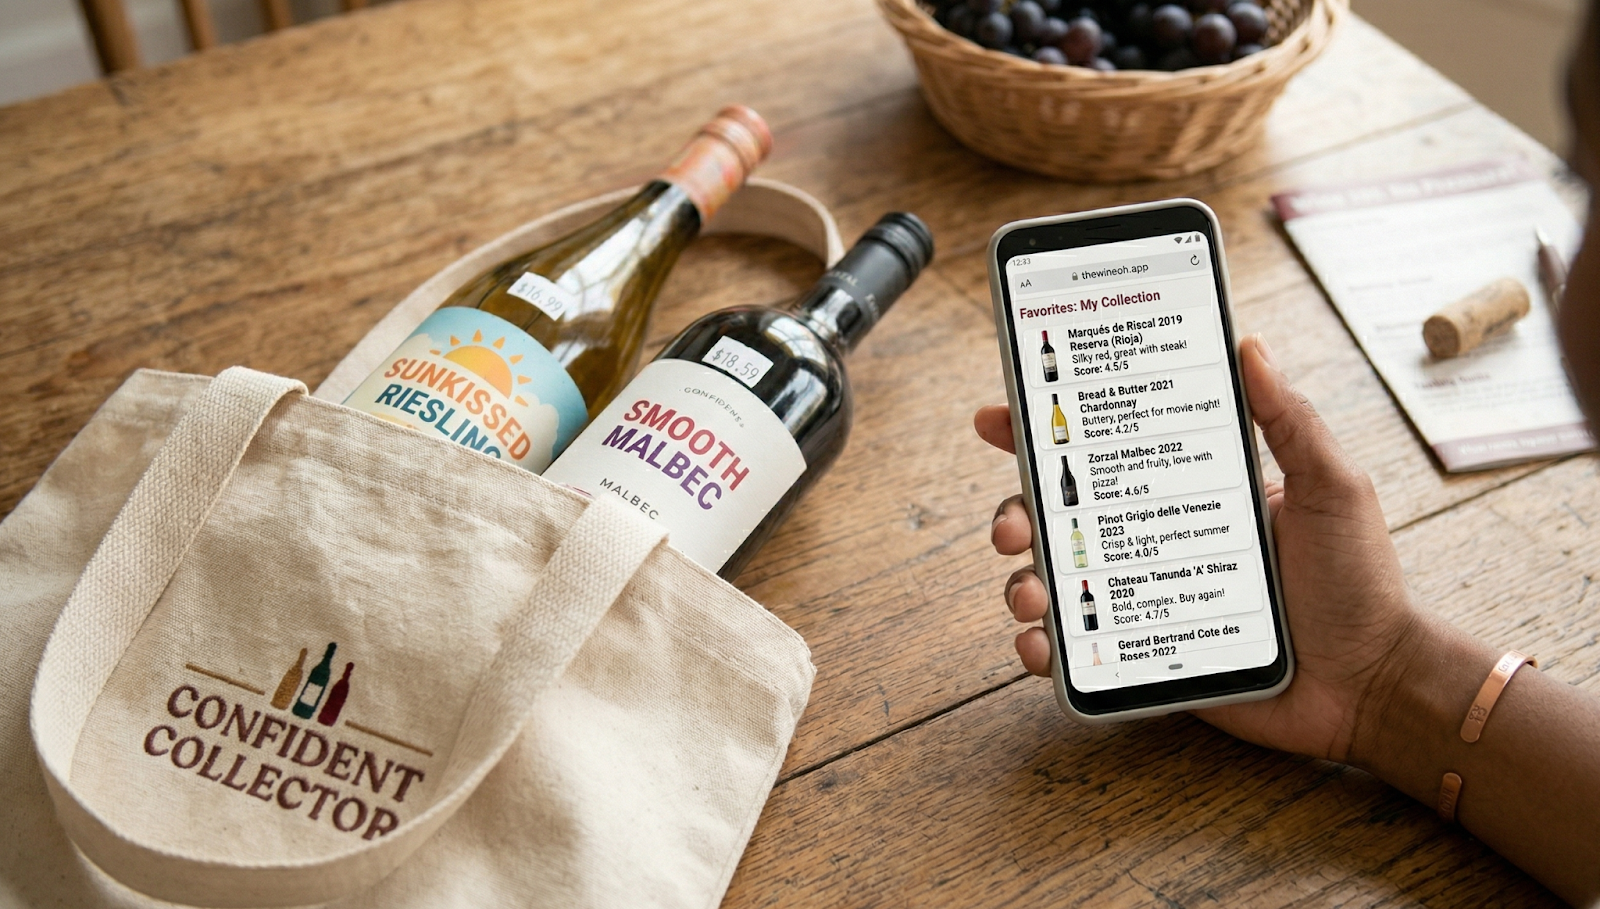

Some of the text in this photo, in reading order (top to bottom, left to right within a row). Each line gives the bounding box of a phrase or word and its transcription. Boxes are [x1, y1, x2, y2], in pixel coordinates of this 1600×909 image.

[1081, 263, 1149, 280] thewineoh.app
[517, 282, 563, 312] $16.99
[1020, 290, 1161, 319] Favorites: My Collection
[1068, 315, 1183, 341] Marqués de Riscal 2019
[1070, 333, 1143, 352] Reserva (Rioja)
[1072, 340, 1188, 366] Silky red, great with steak!
[712, 348, 760, 380] $18.59
[1074, 361, 1129, 376] Score: 4.5/5
[1078, 380, 1174, 402] Bread & Butter 2021
[384, 358, 531, 461] SUNKISSED
[1080, 398, 1137, 414] Chardonnay
[1082, 399, 1220, 427] Buttery, perfect for movie night!
[1084, 423, 1139, 439] Score: 4.2/5
[624, 400, 750, 491] SMOOTH
[1088, 442, 1183, 464] Zorzal Malbec 2022
[601, 425, 722, 510] MALBEC
[1090, 451, 1213, 476] Smooth and fruity, love with
[1092, 477, 1119, 490] pizza!
[1093, 484, 1150, 501] Score: 4.6/5
[600, 478, 659, 520] MALBEC
[1097, 500, 1221, 526] Pinot Grigio delle Venezie
[1100, 525, 1125, 538] 2023
[1101, 524, 1230, 551] Crisp & light, perfect summer
[1103, 546, 1159, 563] Score: 4.0/5
[1108, 560, 1238, 588] Chateau Tanunda 'A' Shiraz
[1109, 587, 1135, 600] 2020
[1112, 588, 1225, 614] Bold, complex. Buy again!
[1113, 609, 1170, 625] Score: 4.7/5
[1118, 625, 1240, 650] Gerard Bertrand Cote des
[1120, 645, 1177, 662] Roses 2022
[167, 684, 425, 803] CONFIDENT
[144, 725, 400, 841] COLLECTOR
